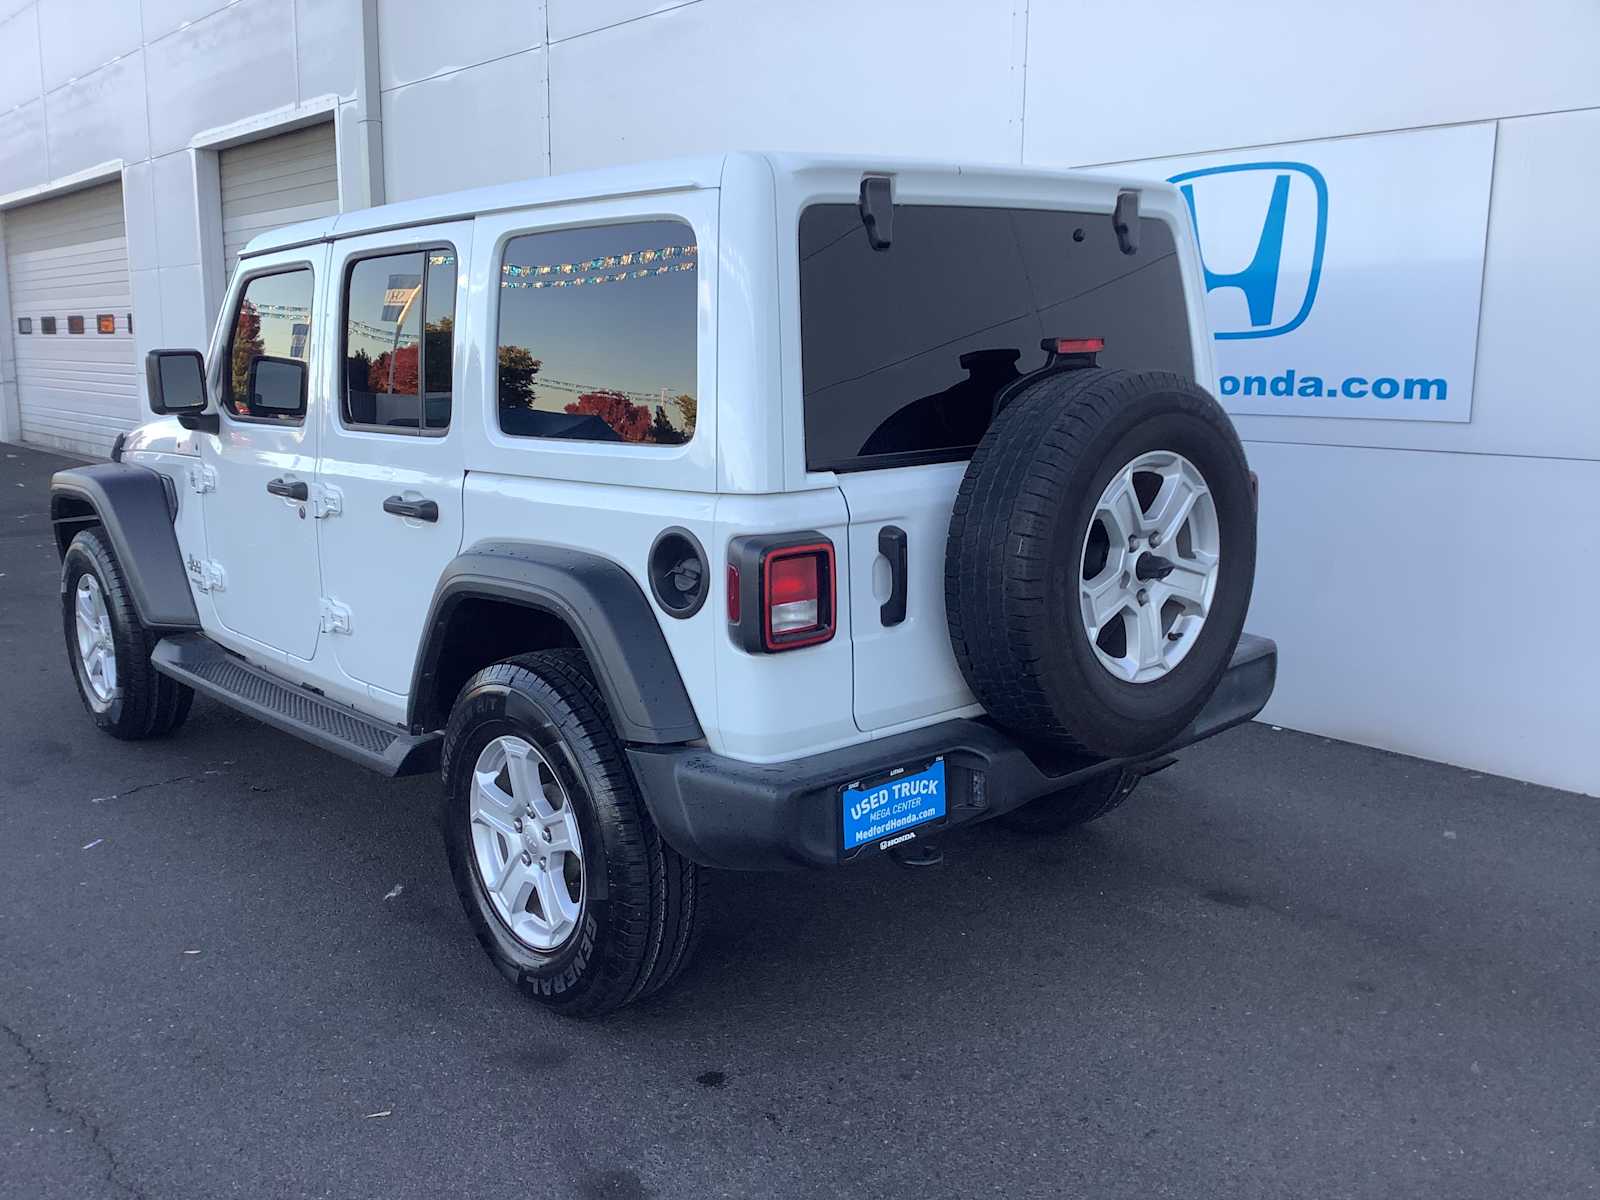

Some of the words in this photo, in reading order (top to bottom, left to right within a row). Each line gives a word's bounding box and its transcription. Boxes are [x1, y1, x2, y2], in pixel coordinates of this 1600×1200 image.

[1219, 369, 1448, 400] onda.com
[851, 789, 889, 820] USED
[892, 780, 939, 799] TRUCK
[869, 808, 891, 822] MEGA
[892, 797, 922, 814] CENTER
[856, 807, 936, 842] MedfordHonda.com
[526, 911, 598, 995] GENERAL
